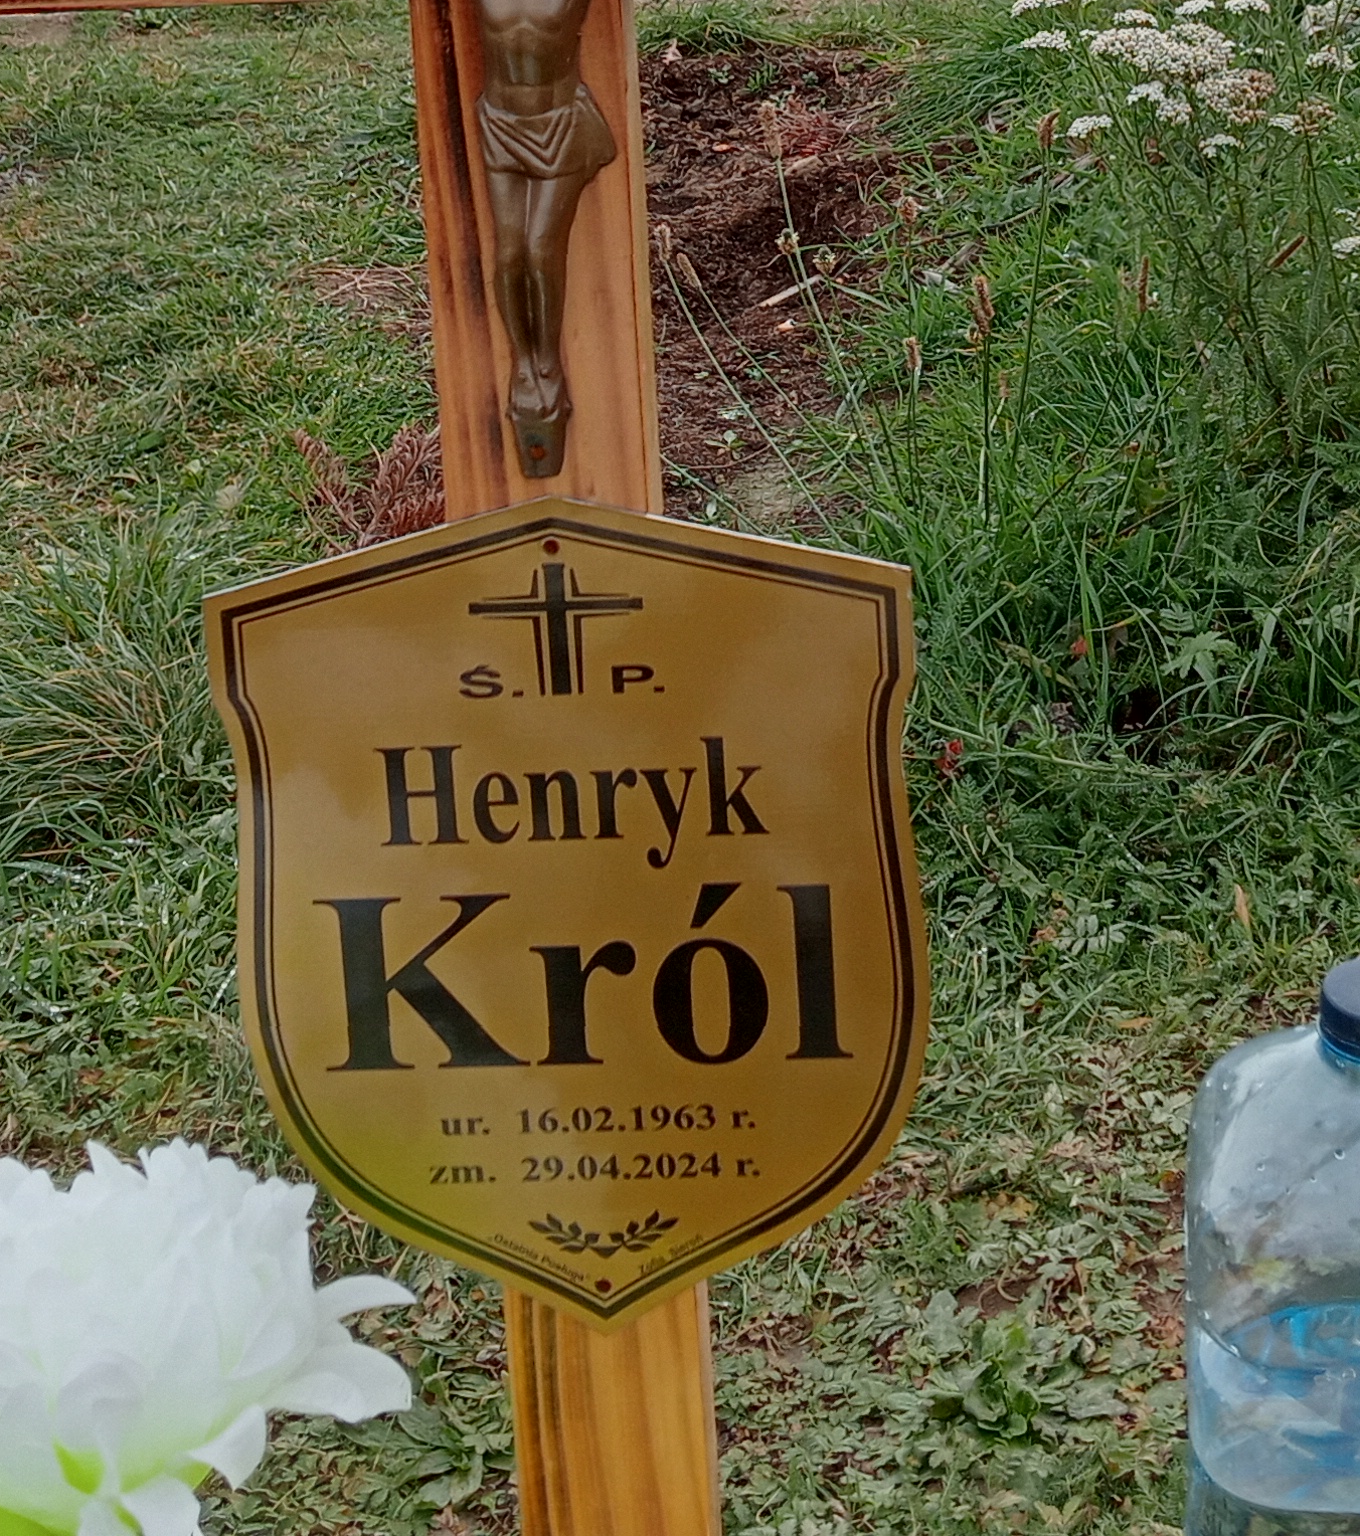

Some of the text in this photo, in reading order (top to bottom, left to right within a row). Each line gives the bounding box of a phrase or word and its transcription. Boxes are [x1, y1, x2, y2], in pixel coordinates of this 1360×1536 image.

[611, 665, 666, 694] P.
[373, 736, 770, 869] Henryk
[312, 880, 854, 1072] Król
[440, 1103, 757, 1138] ur. 16.02.1963 r.
[428, 1151, 761, 1186] zm. 29.04.2024 r.
